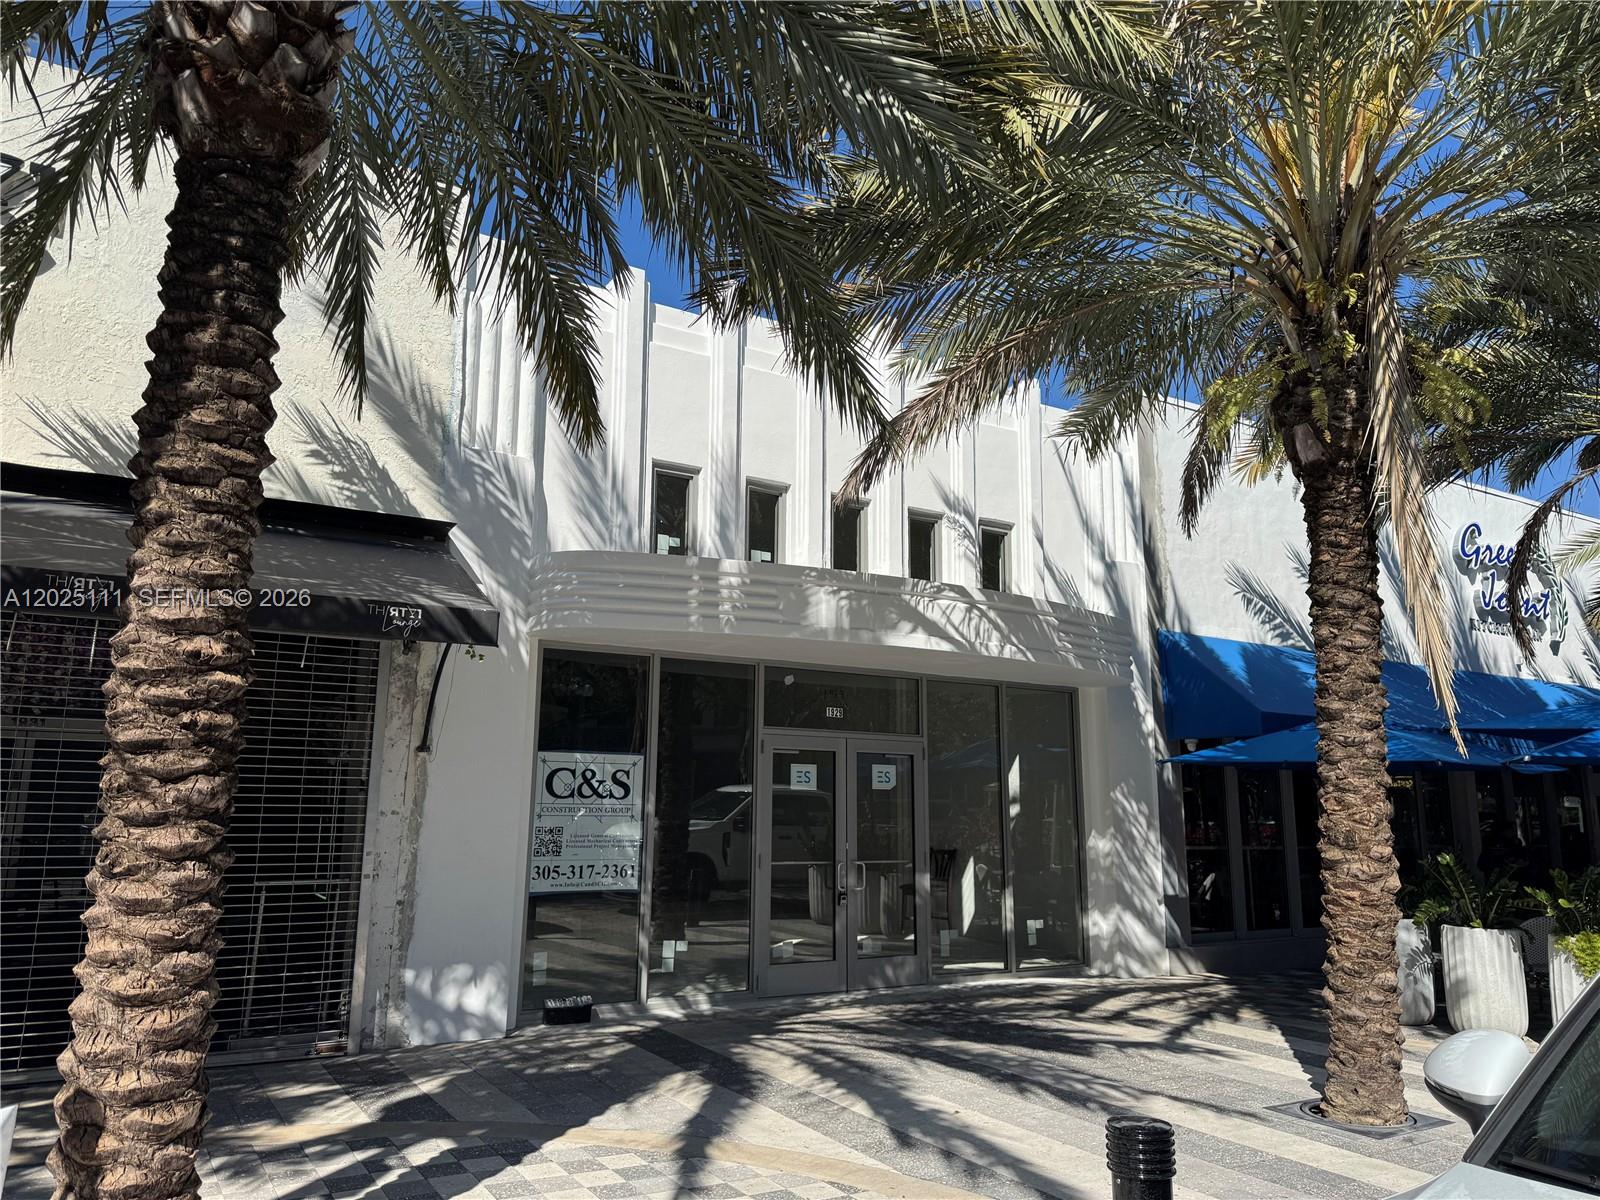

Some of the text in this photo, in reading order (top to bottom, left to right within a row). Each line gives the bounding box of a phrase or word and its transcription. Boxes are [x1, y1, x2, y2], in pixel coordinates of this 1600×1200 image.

[1460, 523, 1516, 569] Gree
[1481, 570, 1551, 620] Jont
[382, 607, 421, 637] Lounge
[827, 707, 843, 717] 1929
[545, 767, 631, 800] C&S
[541, 806, 631, 814] CONSTRUCTION GROUP
[532, 863, 636, 880] 305-317-2361
